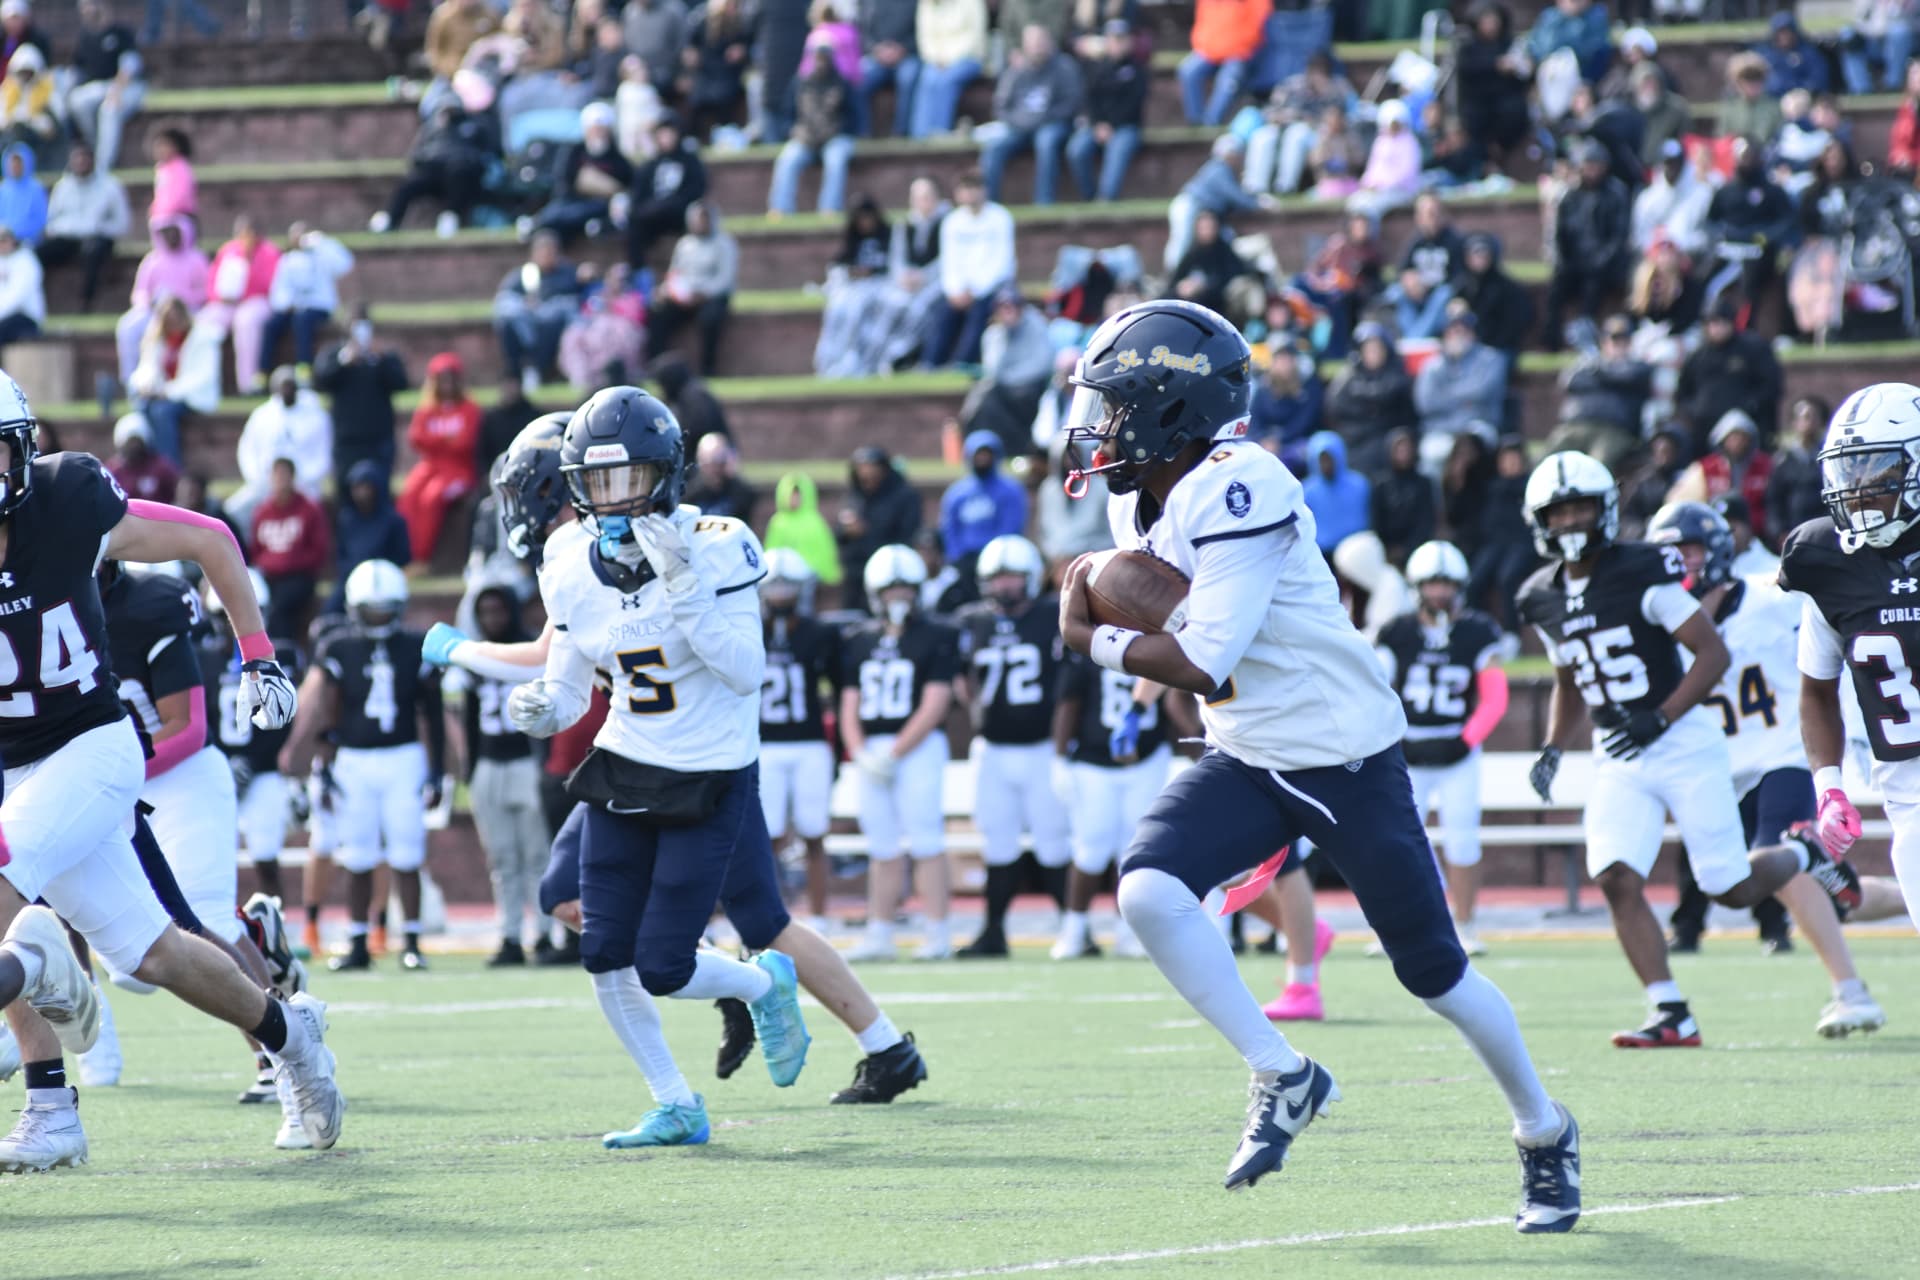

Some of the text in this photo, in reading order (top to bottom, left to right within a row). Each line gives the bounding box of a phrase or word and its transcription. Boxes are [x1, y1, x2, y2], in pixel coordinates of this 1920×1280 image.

[615, 644, 678, 715] 5
[760, 663, 807, 723] 21
[974, 642, 1044, 706] 72
